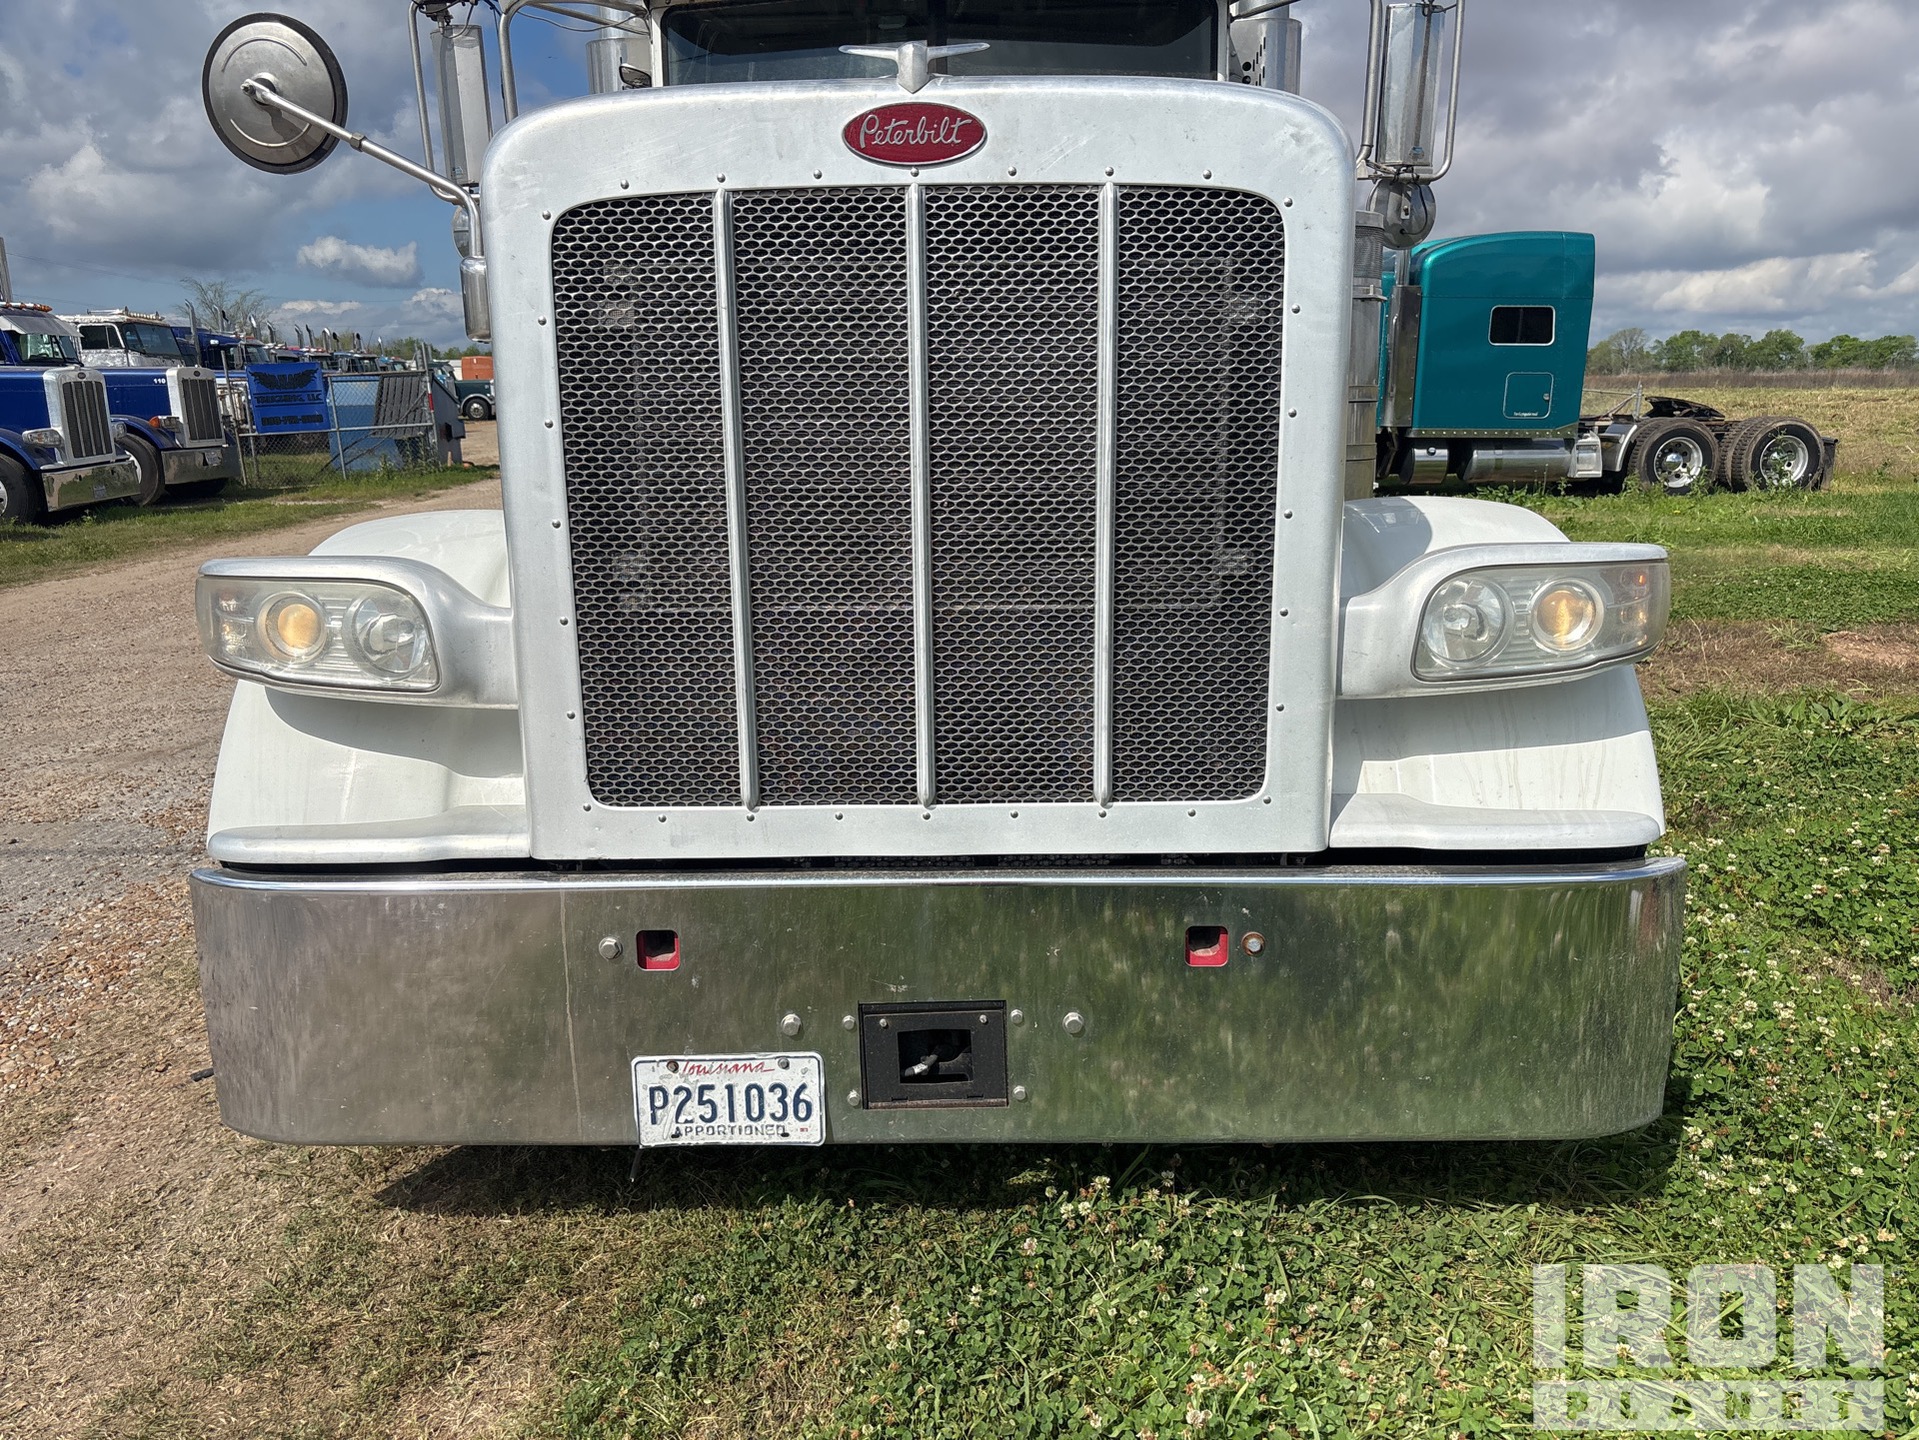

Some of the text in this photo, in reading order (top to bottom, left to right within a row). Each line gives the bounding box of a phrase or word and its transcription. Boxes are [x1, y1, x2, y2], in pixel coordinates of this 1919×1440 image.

[859, 115, 973, 149] Peterbilt
[683, 1061, 775, 1076] Louisiana
[649, 1083, 813, 1125] P251036
[675, 1124, 786, 1137] APPORTIONED
